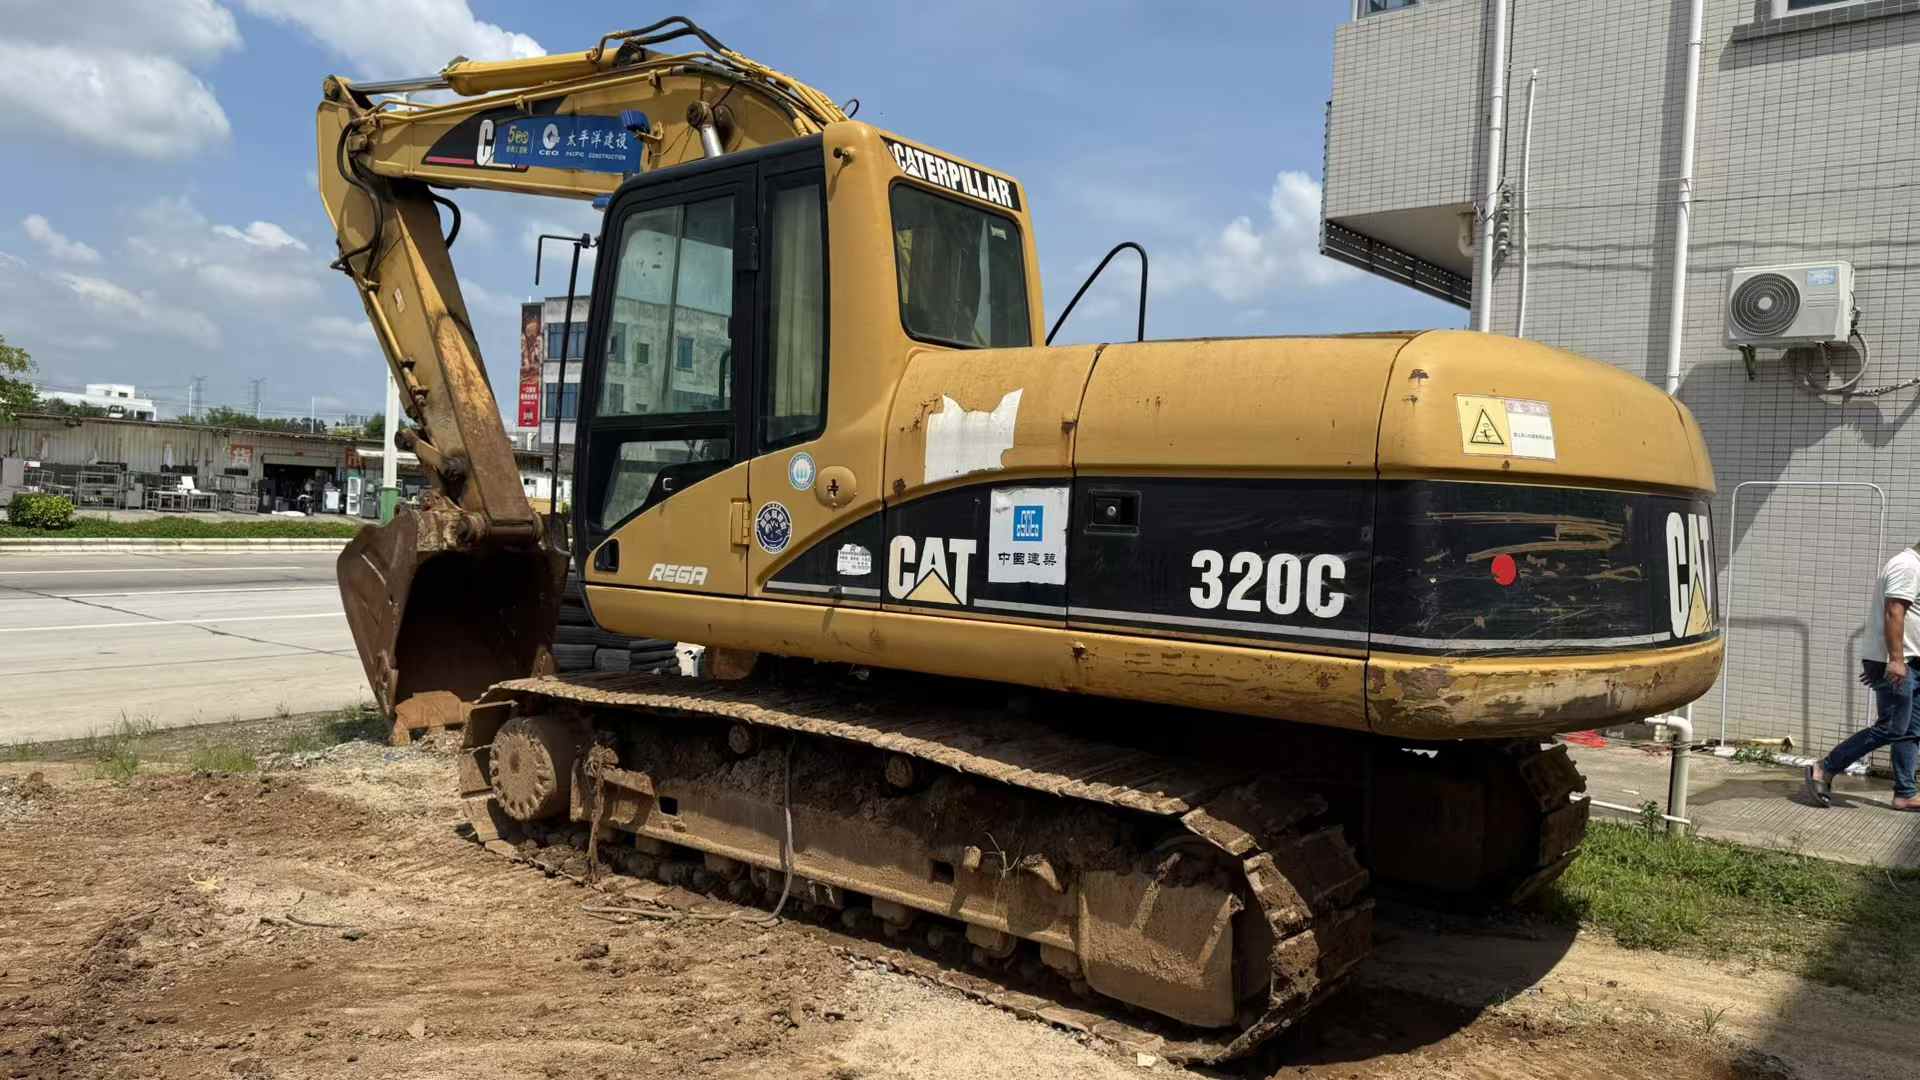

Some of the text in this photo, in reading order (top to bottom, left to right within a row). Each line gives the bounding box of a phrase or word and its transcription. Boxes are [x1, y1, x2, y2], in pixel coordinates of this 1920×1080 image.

[588, 152, 626, 160] CONSTRUCTION
[892, 142, 1013, 208] CATERPILLAR
[648, 563, 708, 585] REGA
[887, 535, 977, 606] CAT
[1189, 549, 1346, 619] 320C
[1666, 511, 1713, 638] CAT
